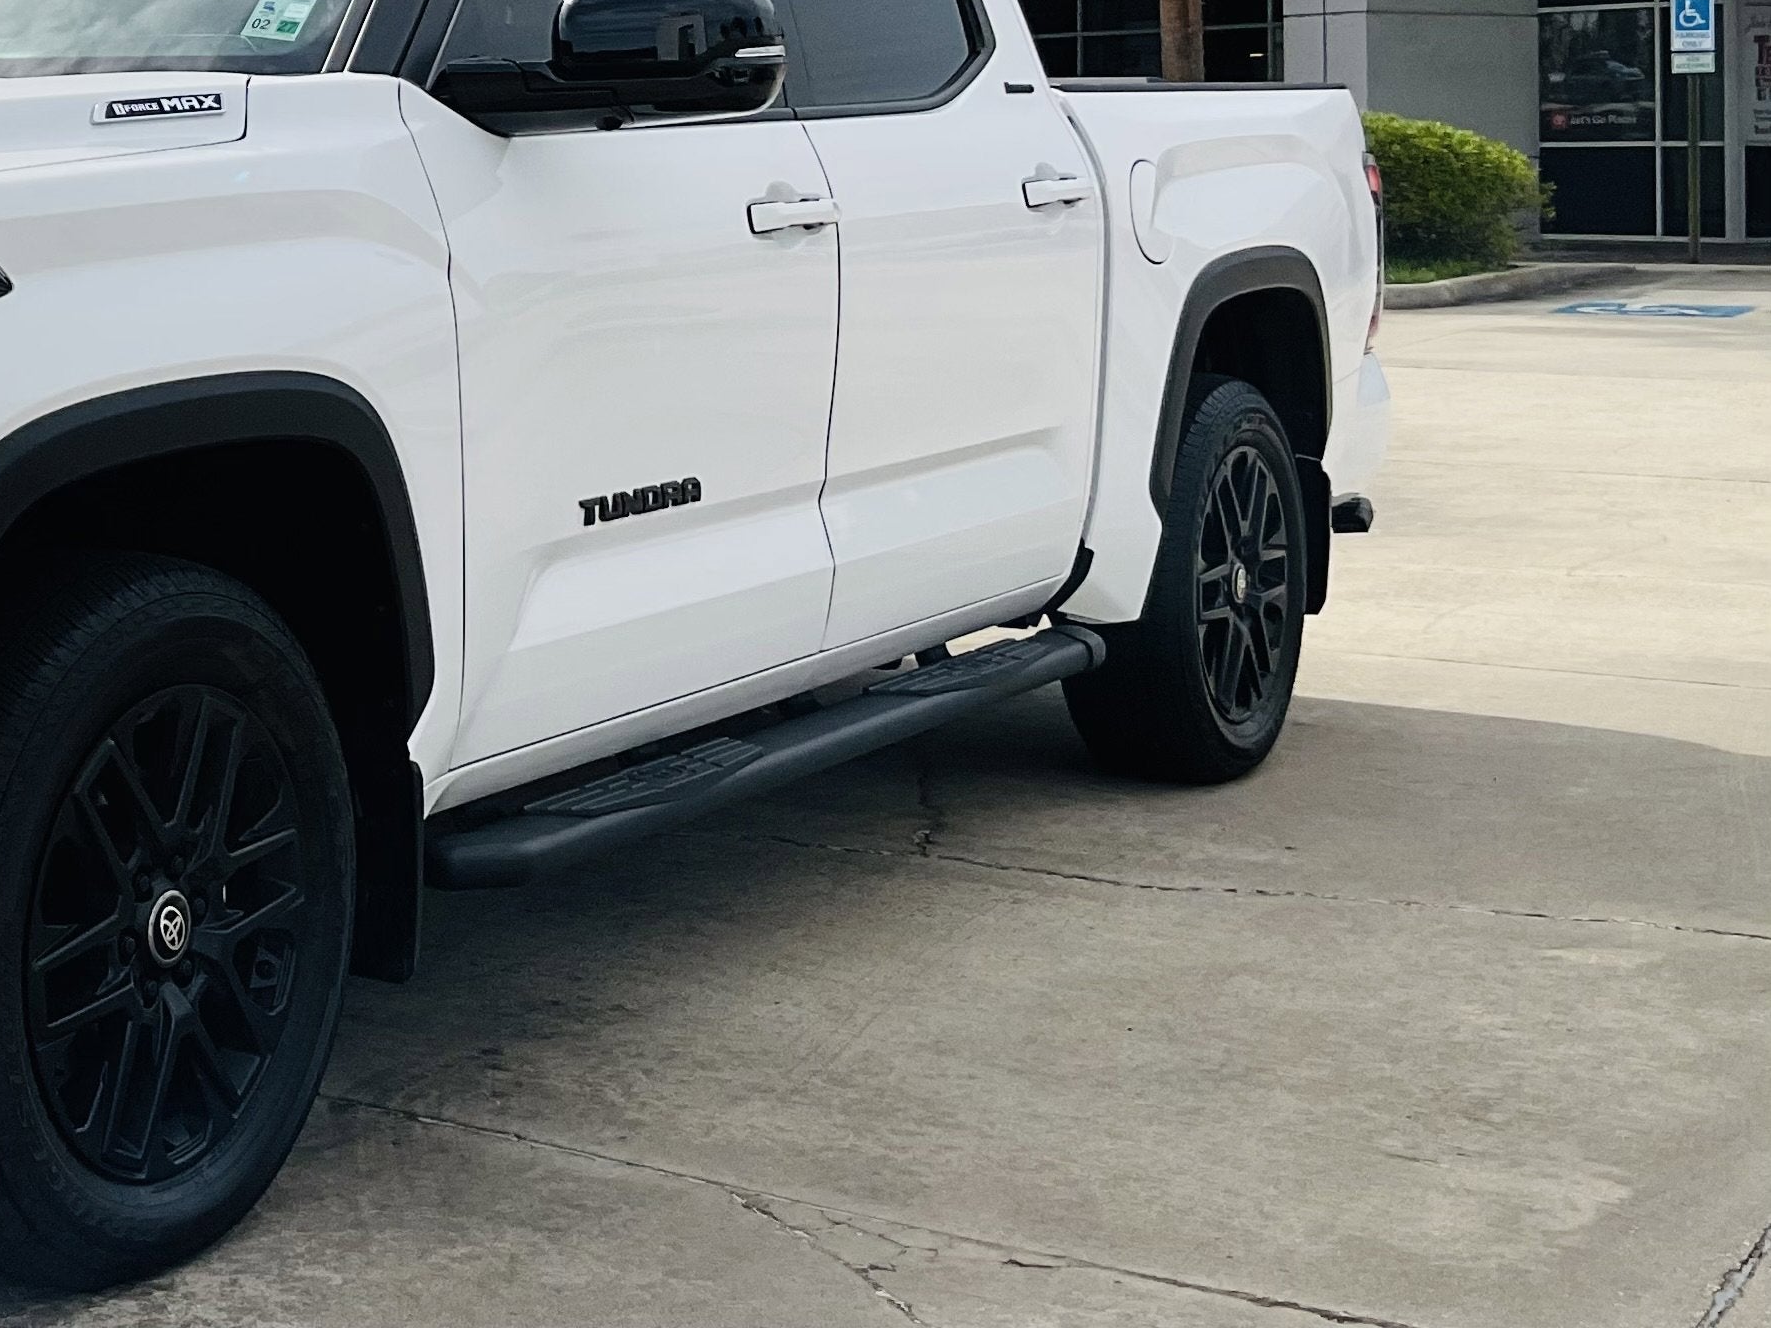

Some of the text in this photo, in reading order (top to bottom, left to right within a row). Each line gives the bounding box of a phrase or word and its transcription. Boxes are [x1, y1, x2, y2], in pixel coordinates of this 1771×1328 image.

[251, 18, 271, 30] 02
[159, 94, 221, 112] MAX
[578, 476, 702, 526] TUNDRA
